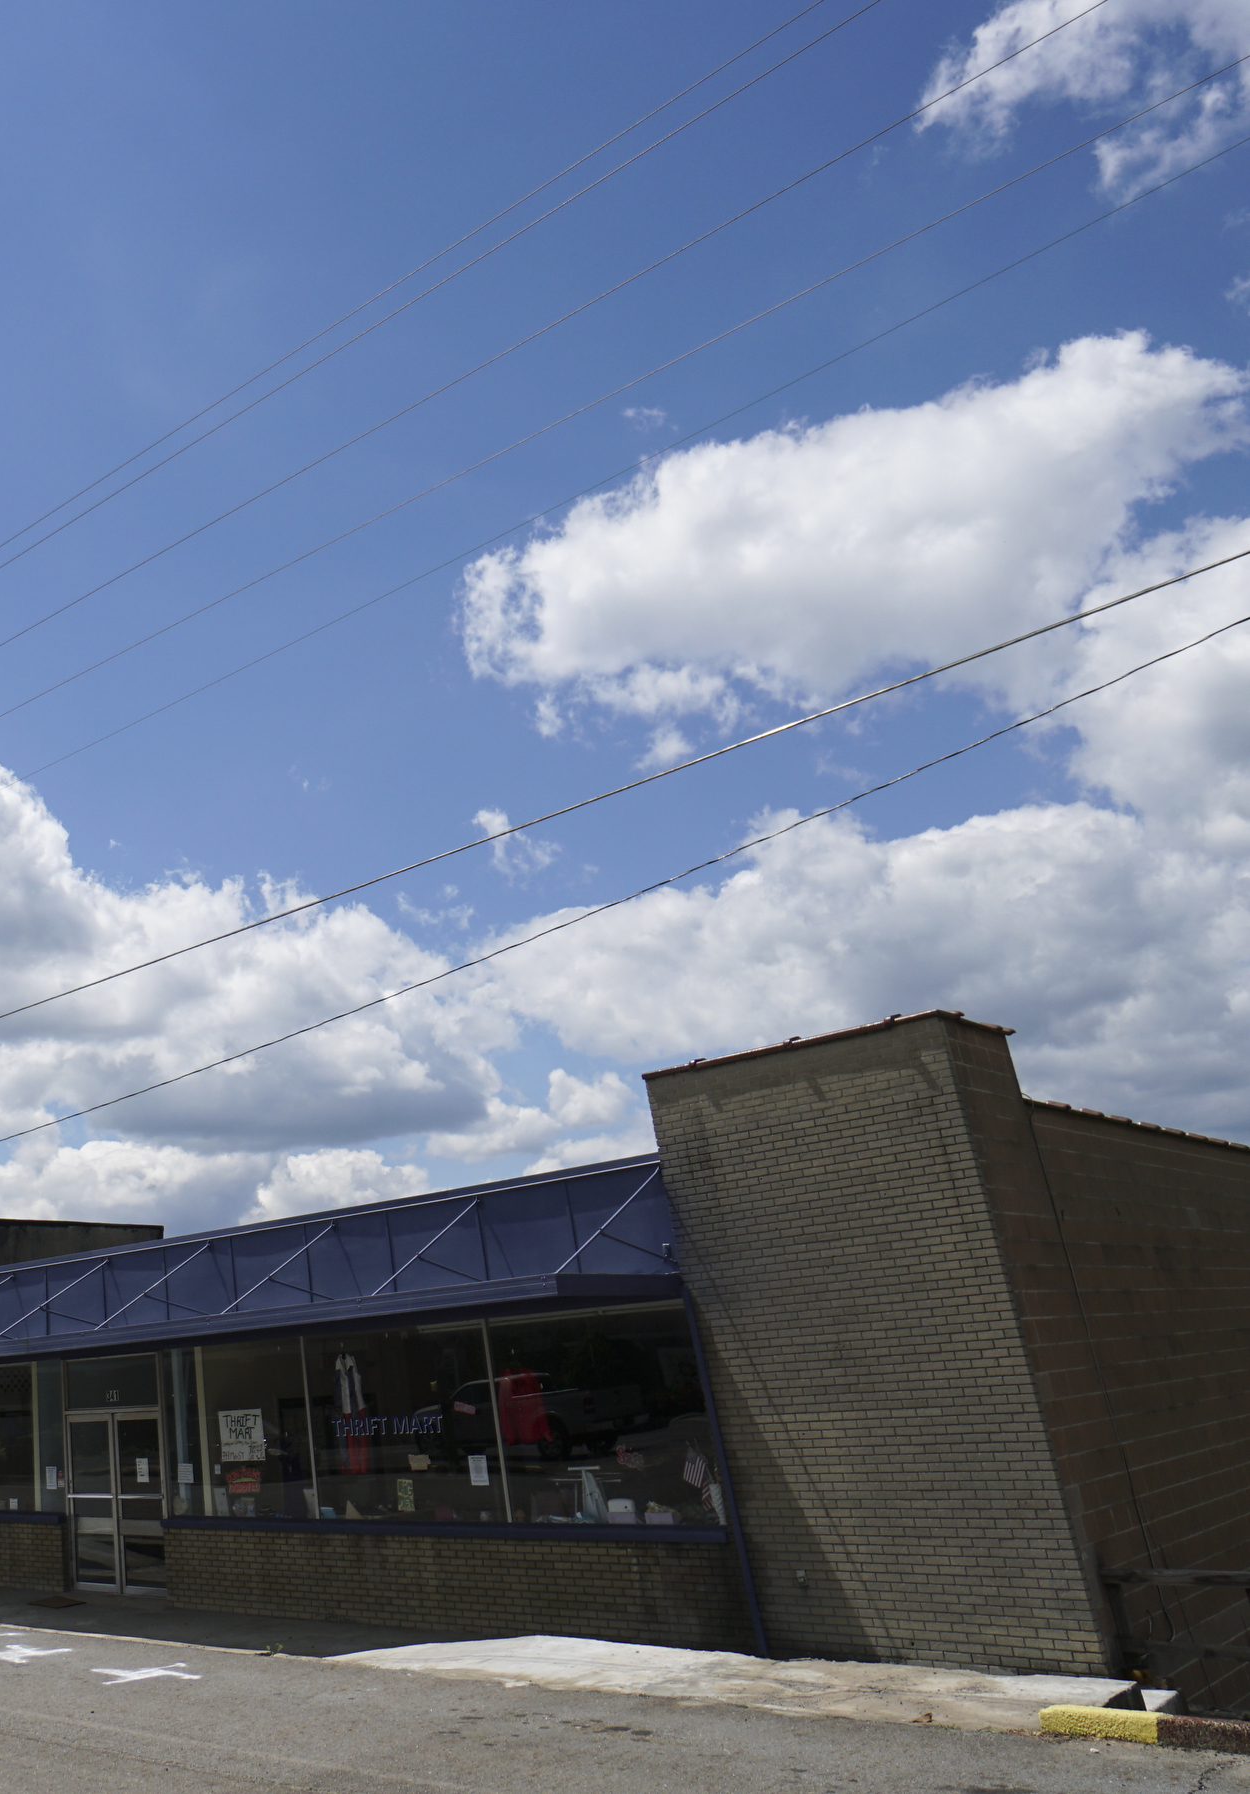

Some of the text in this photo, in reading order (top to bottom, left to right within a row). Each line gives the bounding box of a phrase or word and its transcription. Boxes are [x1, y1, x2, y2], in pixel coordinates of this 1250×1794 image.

[106, 1390, 120, 1402] 341
[222, 1413, 260, 1428] THRIFT
[331, 1413, 444, 1437] THRIFT MART
[229, 1426, 256, 1440] MART
